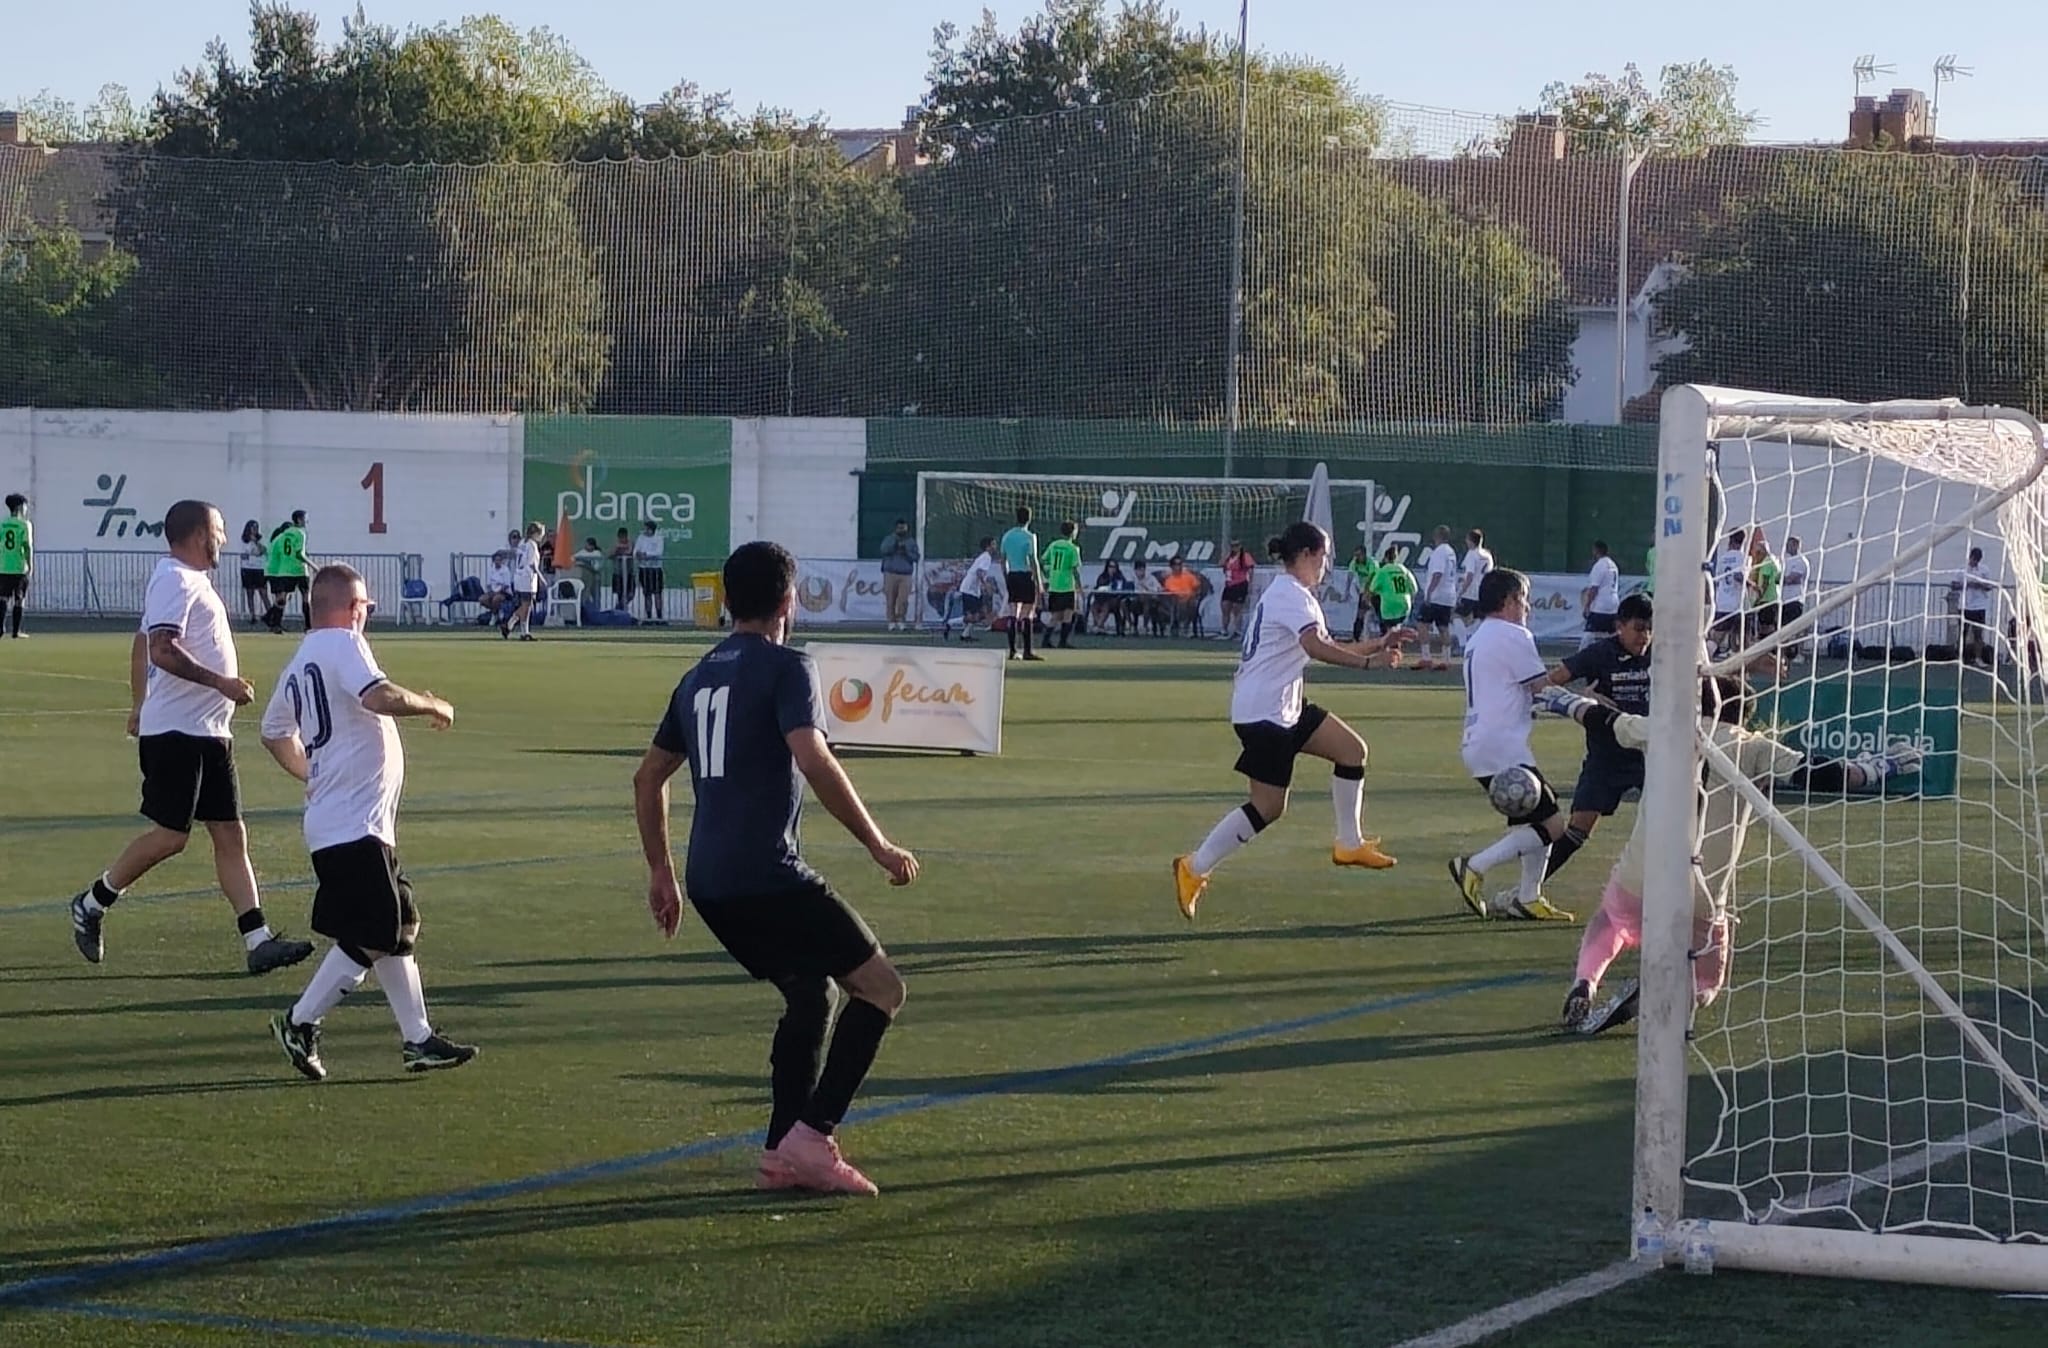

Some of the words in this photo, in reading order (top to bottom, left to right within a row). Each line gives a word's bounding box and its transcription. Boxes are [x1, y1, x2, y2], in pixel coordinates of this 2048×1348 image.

[361, 462, 387, 534] 1
[557, 465, 696, 533] planea
[5, 530, 15, 550] 8
[283, 538, 291, 556] 6
[881, 669, 975, 723] fecam
[693, 685, 730, 779] 11
